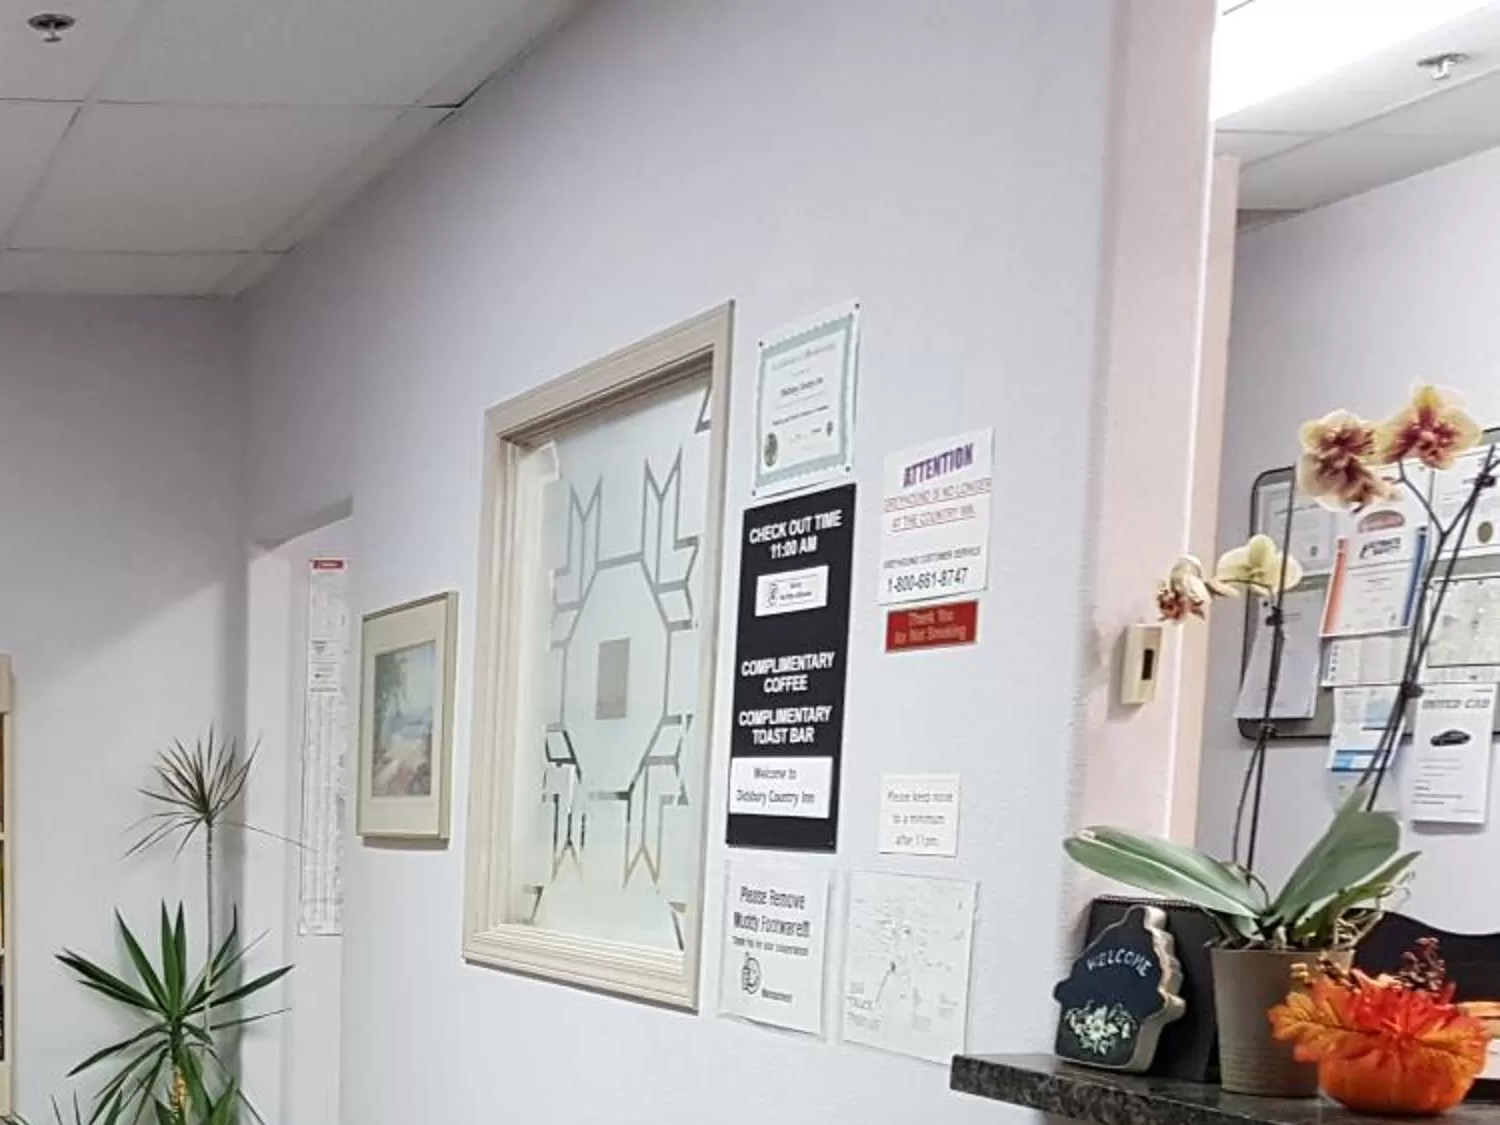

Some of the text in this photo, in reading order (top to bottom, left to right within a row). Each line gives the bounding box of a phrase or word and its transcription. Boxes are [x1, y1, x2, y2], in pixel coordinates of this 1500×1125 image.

[902, 442, 973, 488] ATTENTION
[749, 509, 843, 544] CHECK OUT TIME
[770, 535, 818, 559] 11:00 AM
[741, 651, 836, 676] COMPLIMENTARY
[763, 674, 809, 693] COFFEE
[738, 705, 833, 727] COMPLIMENTARY
[752, 727, 815, 745] TOAST BAR
[754, 768, 797, 780] Welcome to
[768, 790, 799, 807] Country
[801, 791, 815, 804] Inn
[739, 886, 805, 910] Please Remove
[733, 912, 757, 932] Muddy
[1086, 948, 1153, 977] WELCOME
